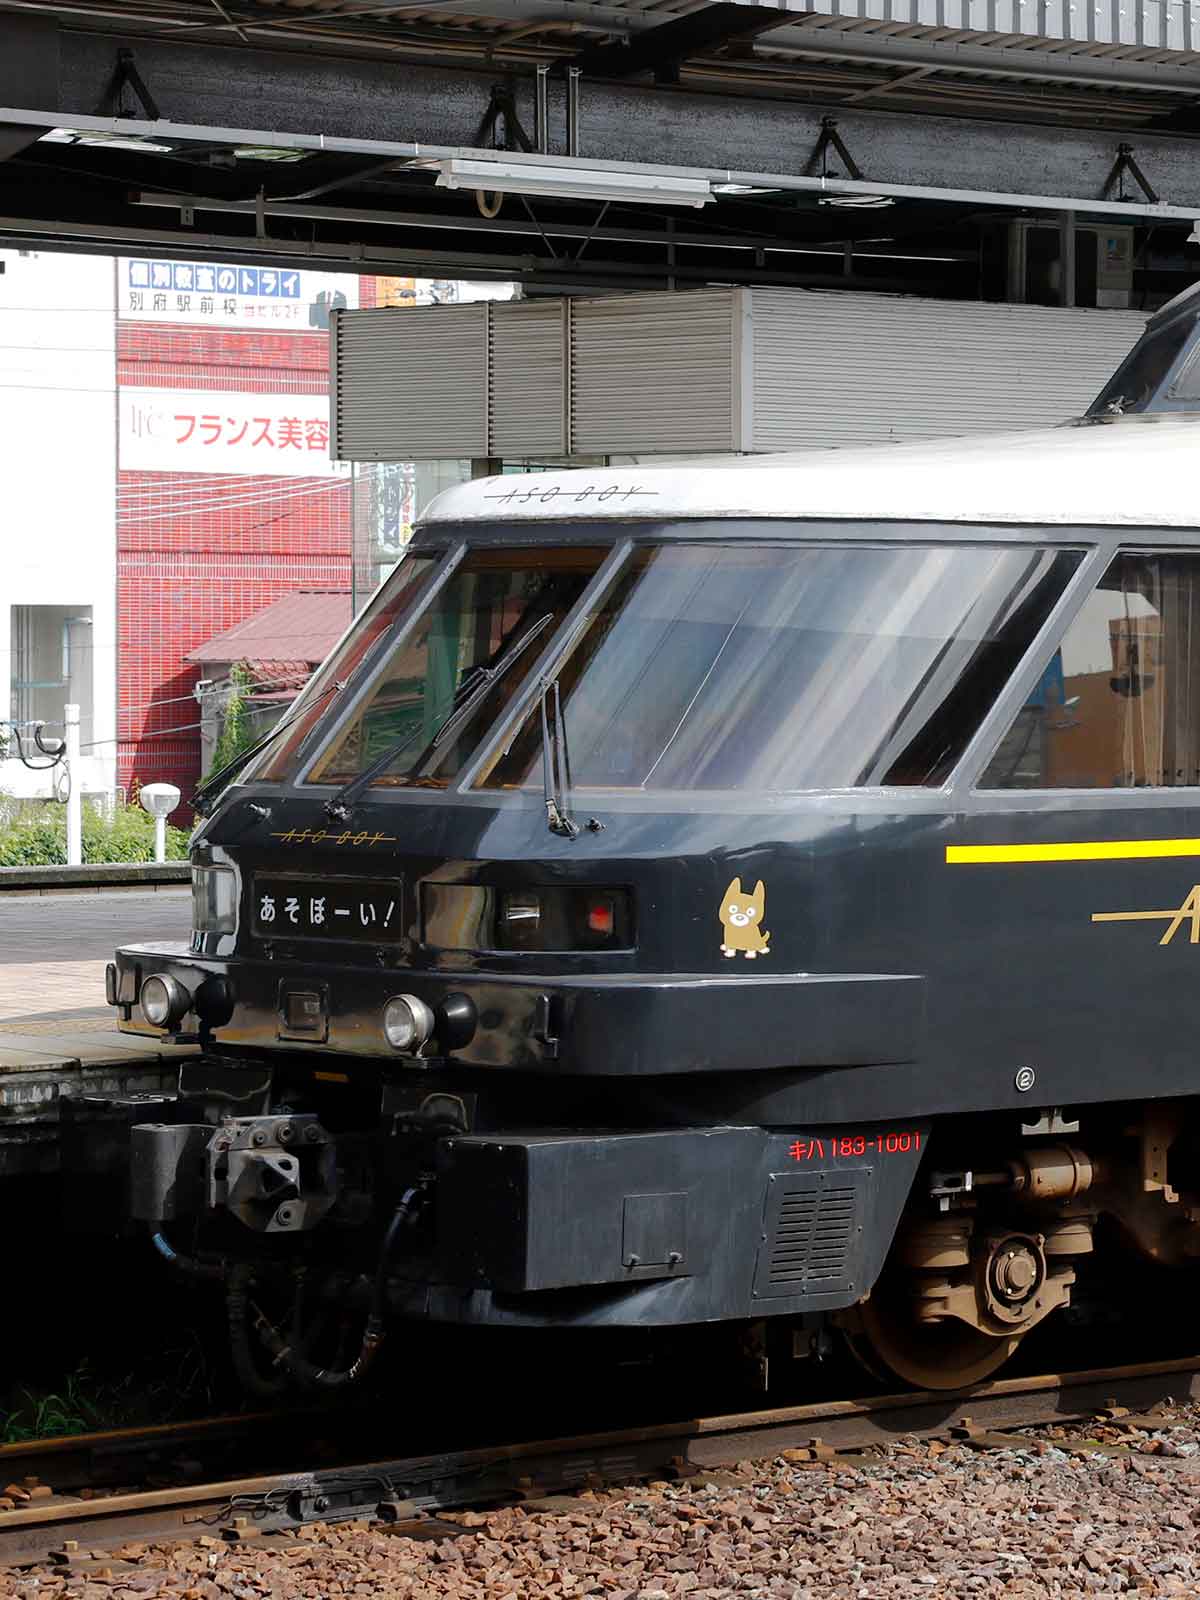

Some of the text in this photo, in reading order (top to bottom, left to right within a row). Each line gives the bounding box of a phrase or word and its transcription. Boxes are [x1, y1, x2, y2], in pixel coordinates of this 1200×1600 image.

[129, 291, 237, 315] 別府駅前校
[174, 415, 329, 450] フランス美容
[498, 486, 643, 504] ASO BOY
[280, 829, 384, 846] ASO BOY
[789, 1132, 921, 1161] キハ 183-1001
